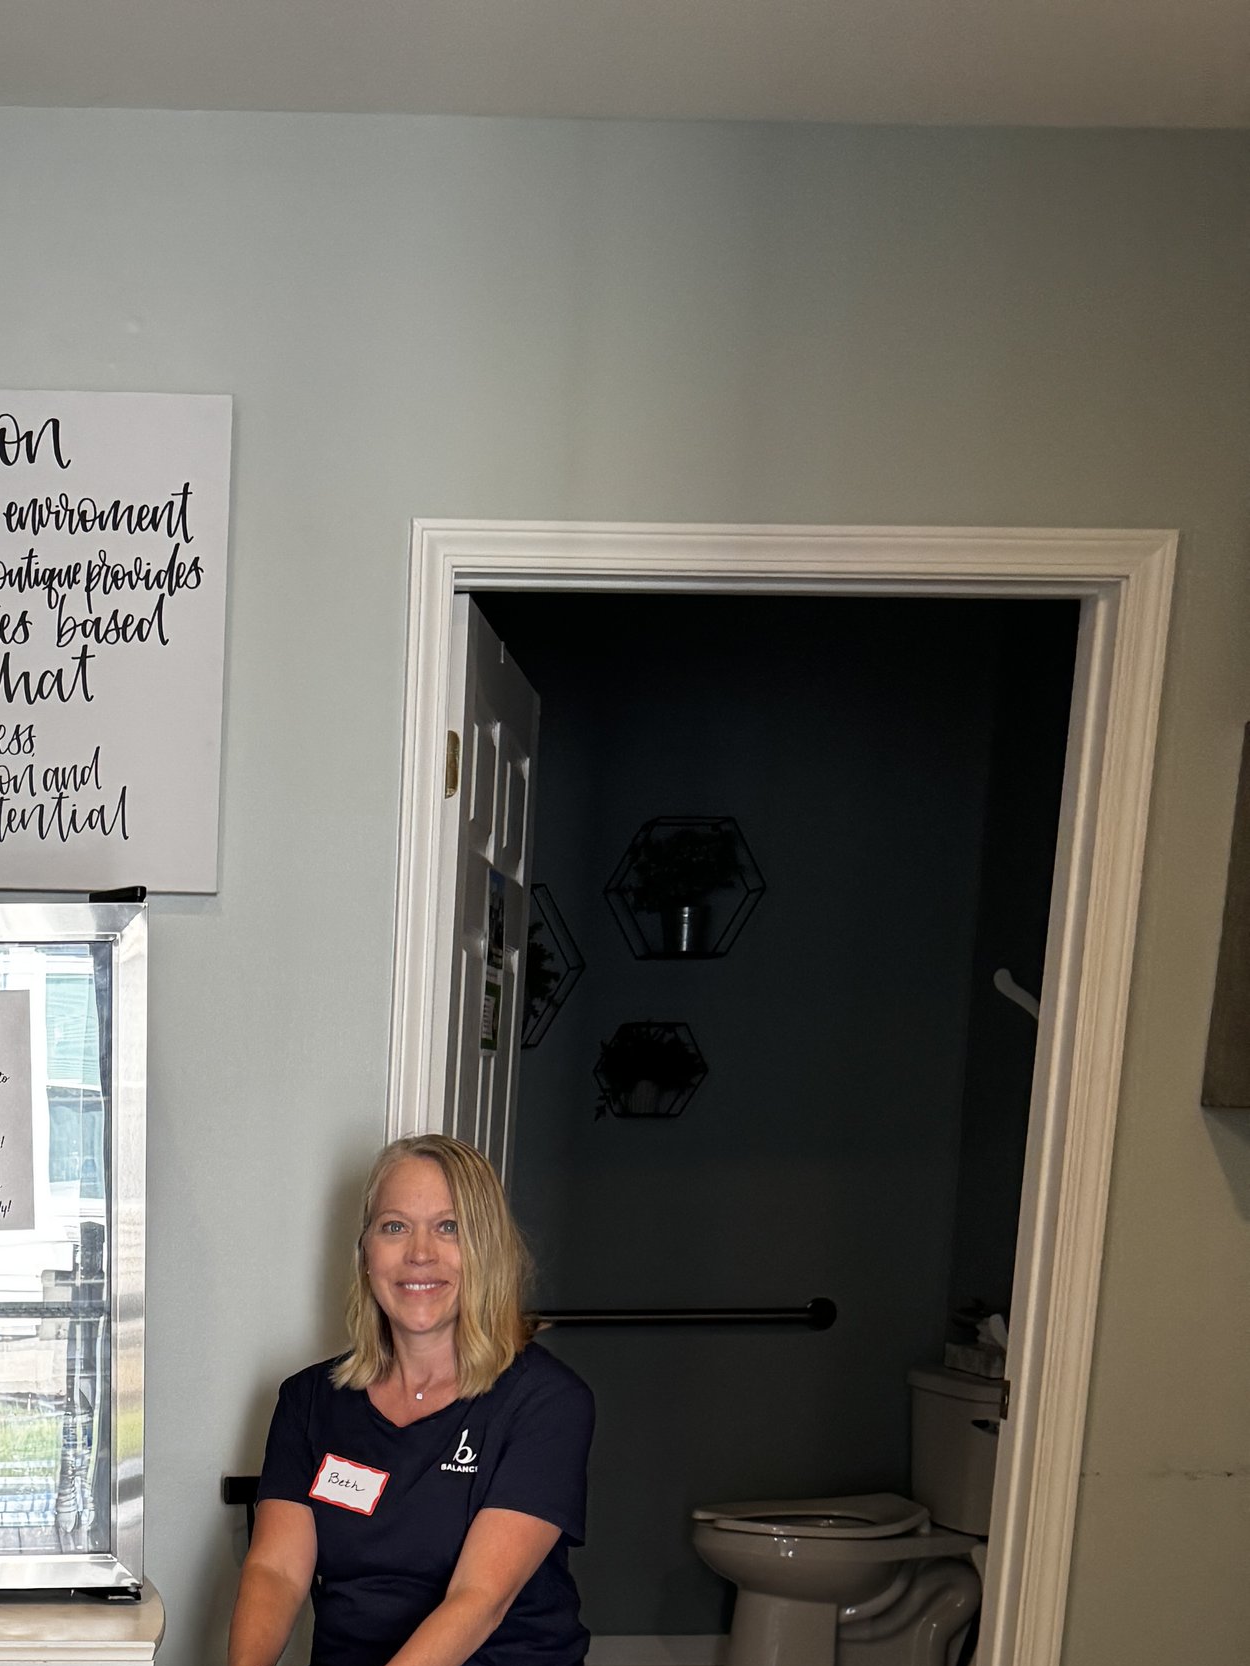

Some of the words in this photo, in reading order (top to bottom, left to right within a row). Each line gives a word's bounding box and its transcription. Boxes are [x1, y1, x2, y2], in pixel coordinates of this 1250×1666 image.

[3, 482, 194, 543] enviroment
[84, 543, 204, 618] provides
[56, 594, 170, 648] based
[43, 746, 101, 797] and
[327, 1472, 365, 1492] Beth
